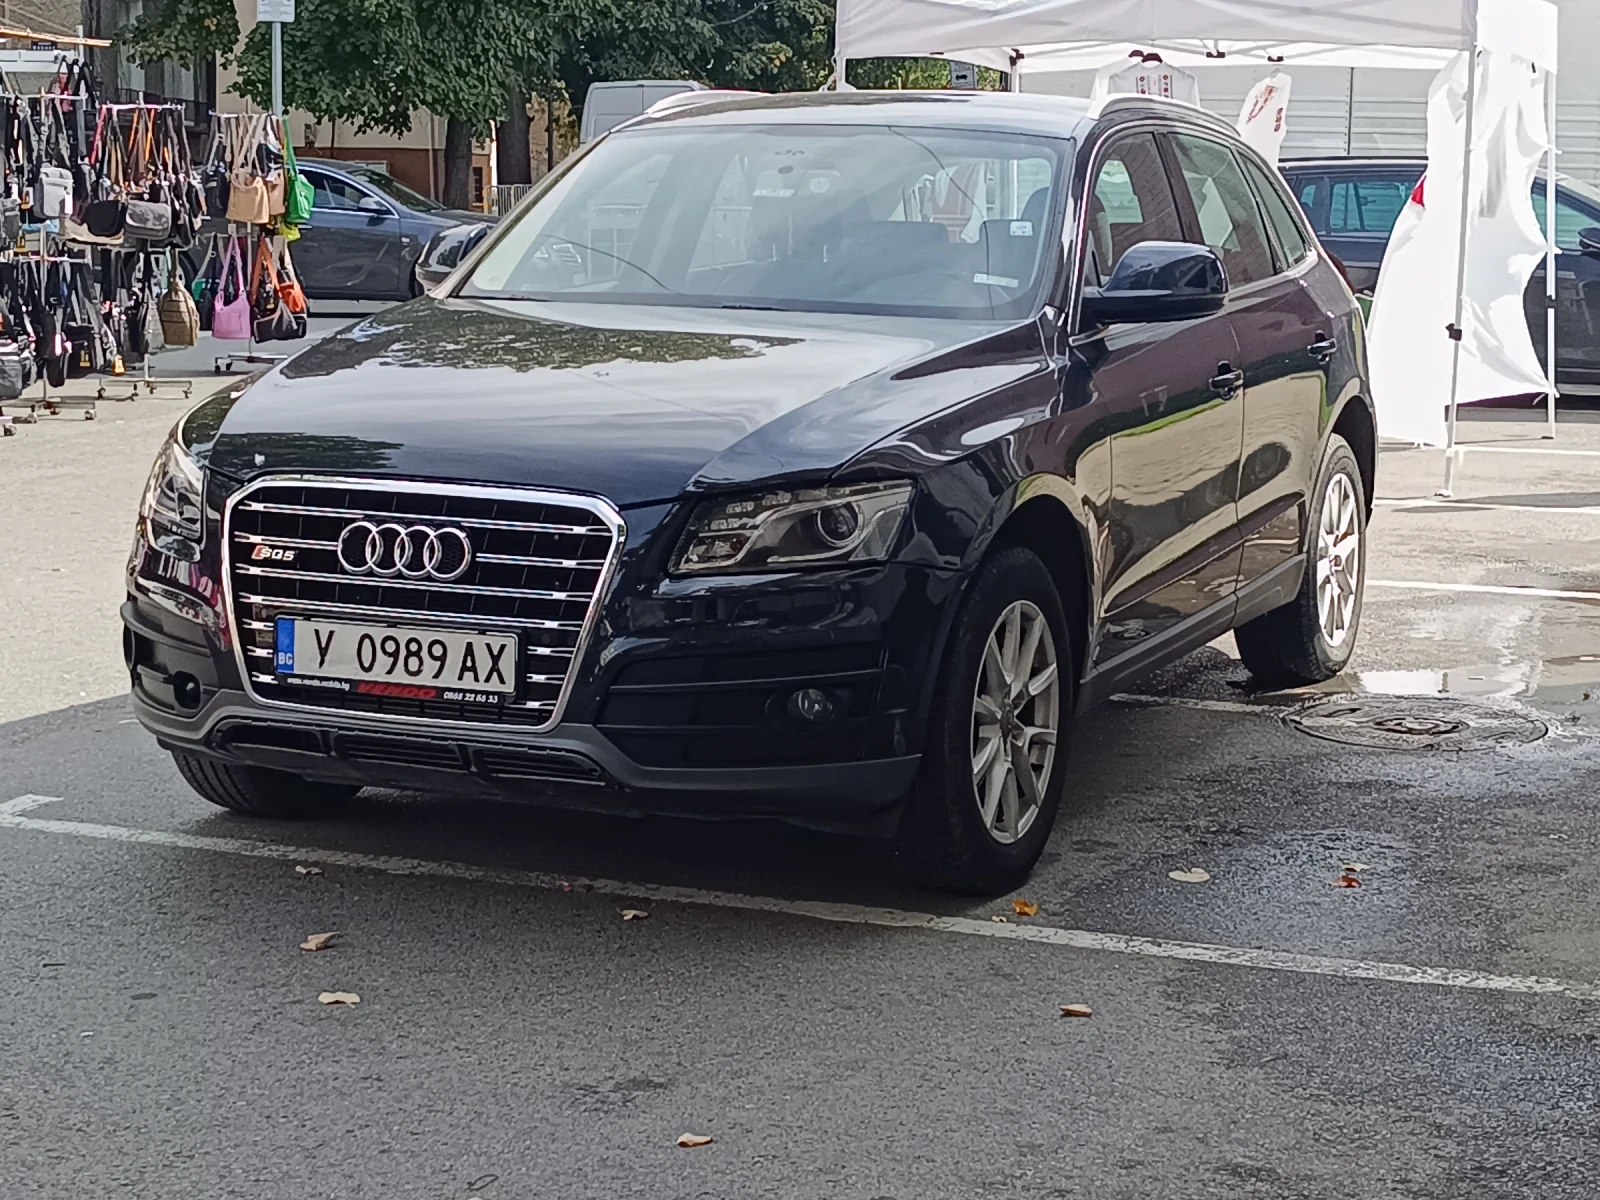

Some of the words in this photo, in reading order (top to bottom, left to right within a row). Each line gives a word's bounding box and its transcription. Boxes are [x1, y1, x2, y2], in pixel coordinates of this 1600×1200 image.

[257, 545, 295, 561] SQ5
[277, 653, 293, 666] BG
[313, 628, 336, 669] Y
[356, 633, 448, 680] 0989
[457, 641, 507, 685] AX
